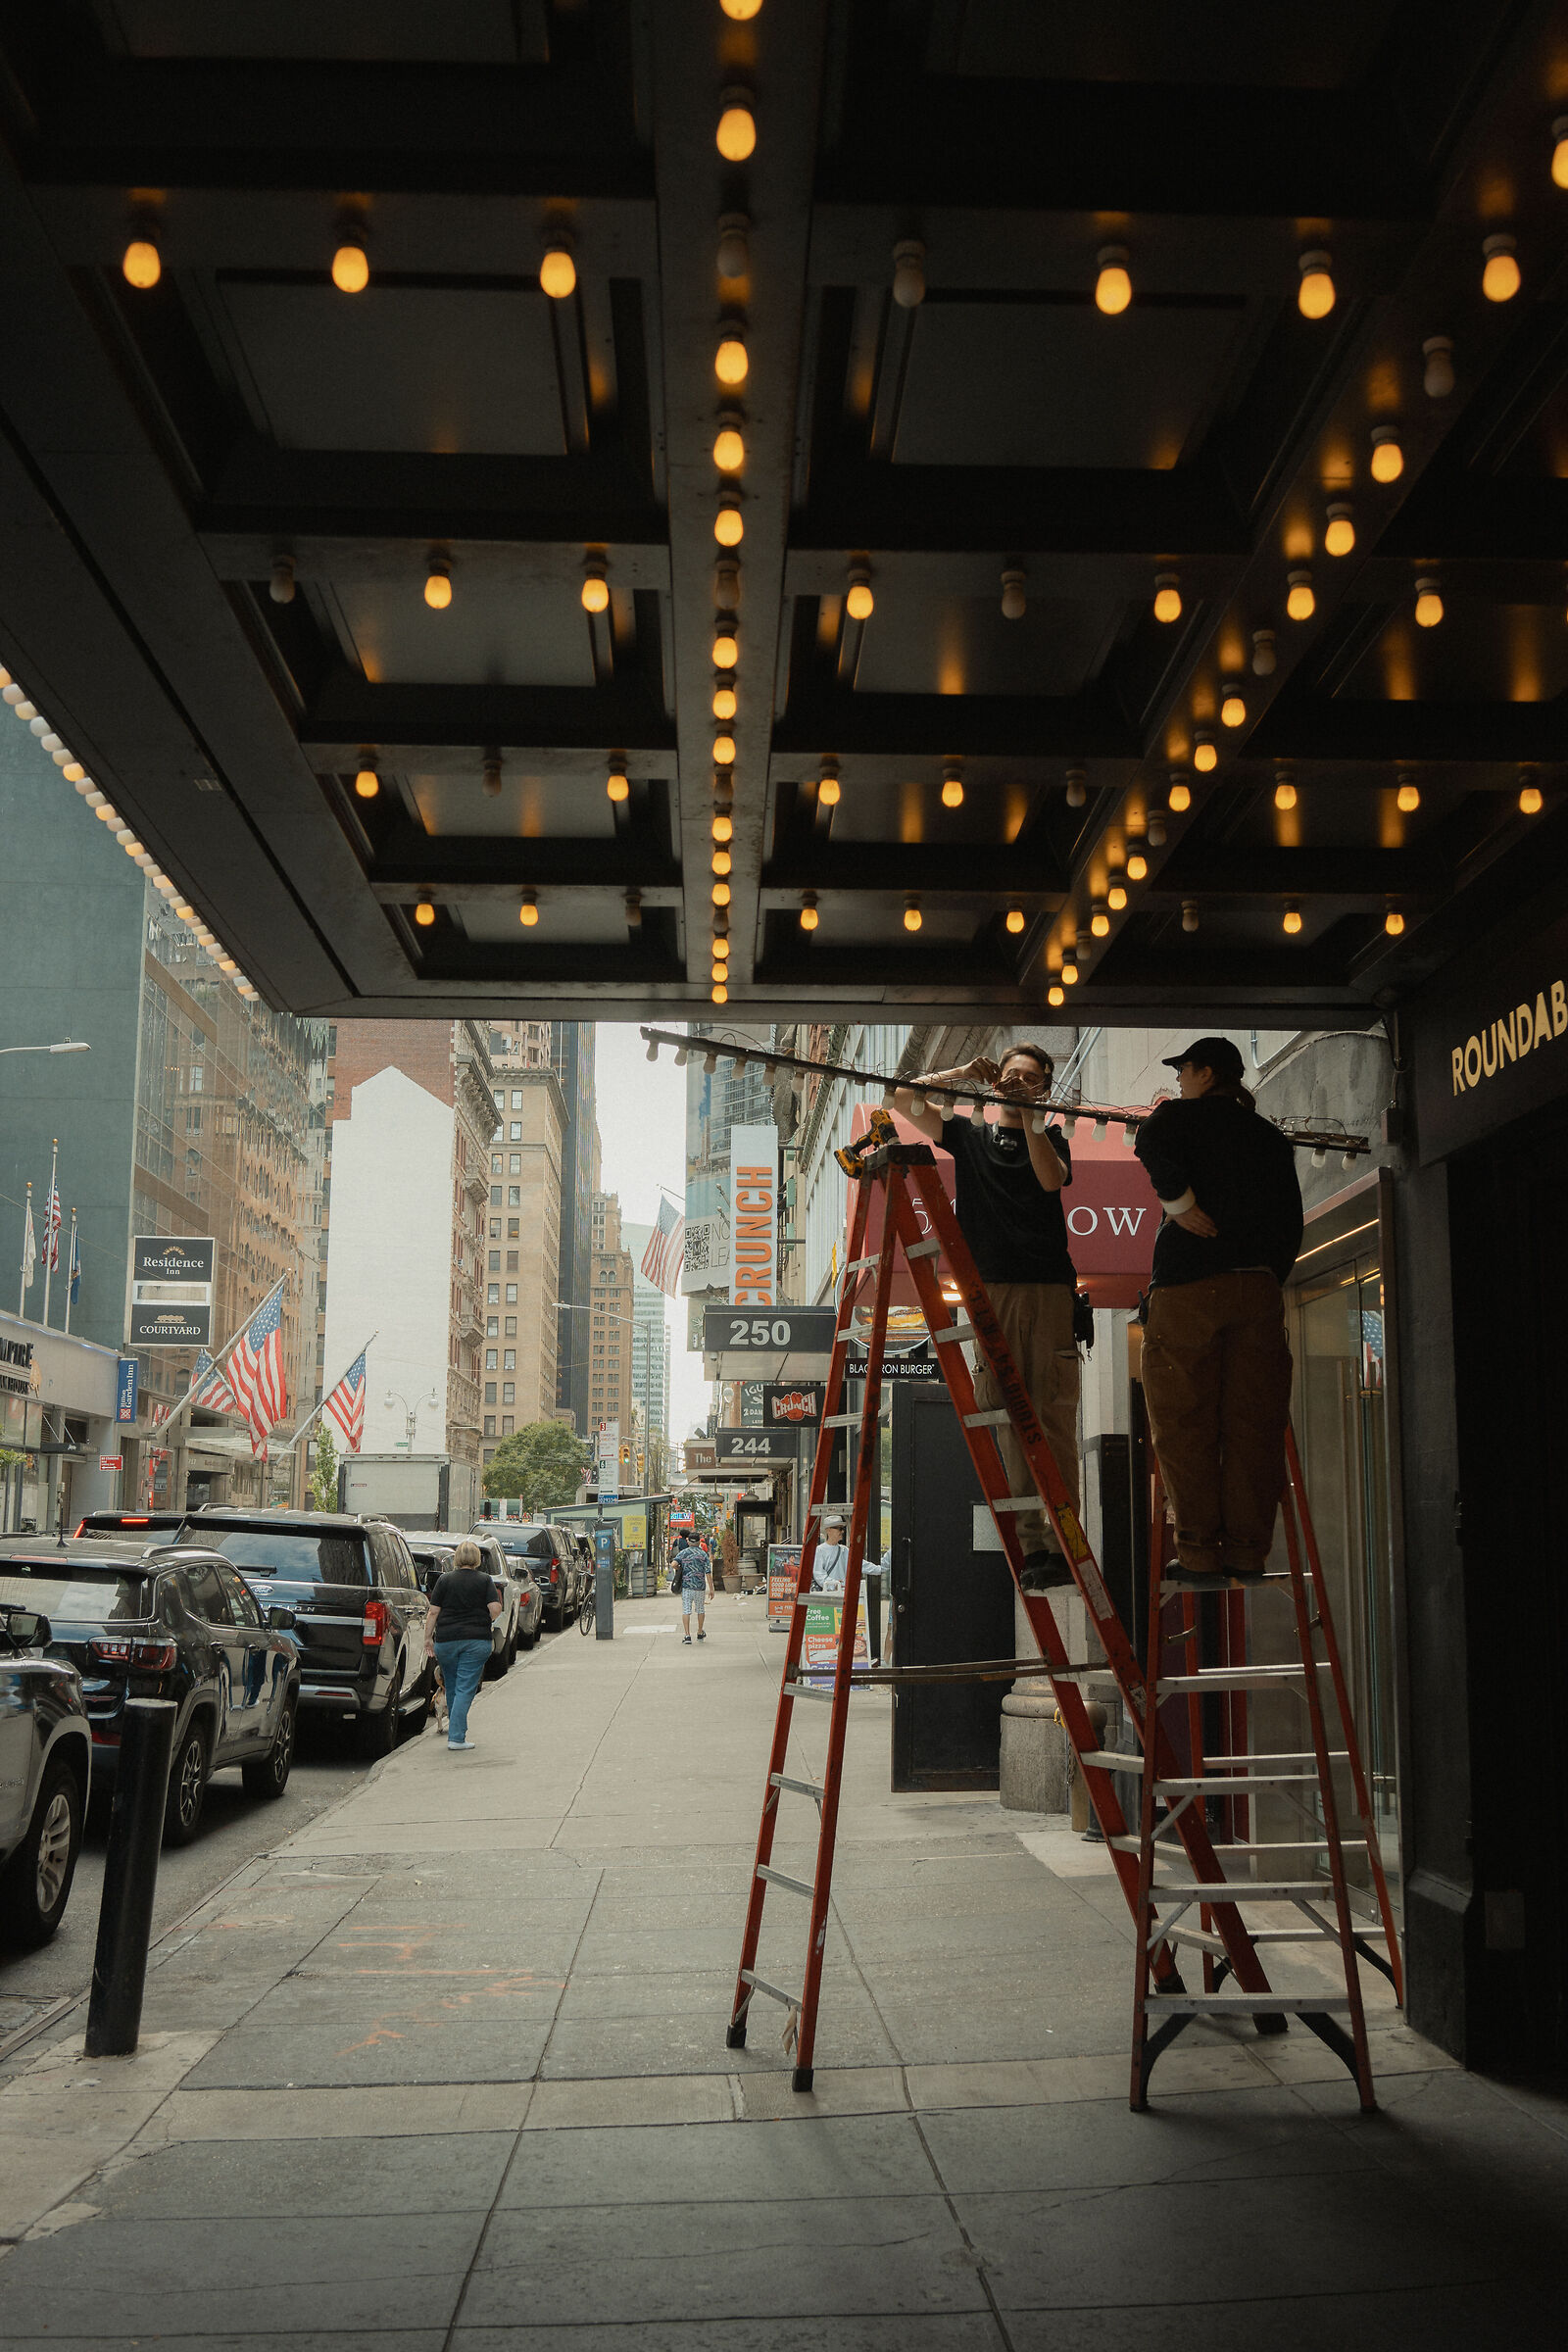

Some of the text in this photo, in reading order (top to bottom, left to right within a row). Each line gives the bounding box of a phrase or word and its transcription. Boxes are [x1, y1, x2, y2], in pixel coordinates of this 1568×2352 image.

[1451, 980, 1568, 1097] ROUNDAB
[711, 1221, 730, 1241] NO
[735, 1166, 773, 1305] CRUNCH
[143, 1256, 204, 1268] Residence
[139, 1325, 201, 1335] COURTYARD
[729, 1320, 791, 1346] 250
[849, 1363, 868, 1373] BLAC
[900, 1363, 933, 1374] BURGER
[745, 1384, 763, 1396] IGU
[743, 1408, 750, 1417] 2
[772, 1392, 815, 1419] CRUNCH
[731, 1438, 771, 1454] 244
[695, 1453, 712, 1464] The
